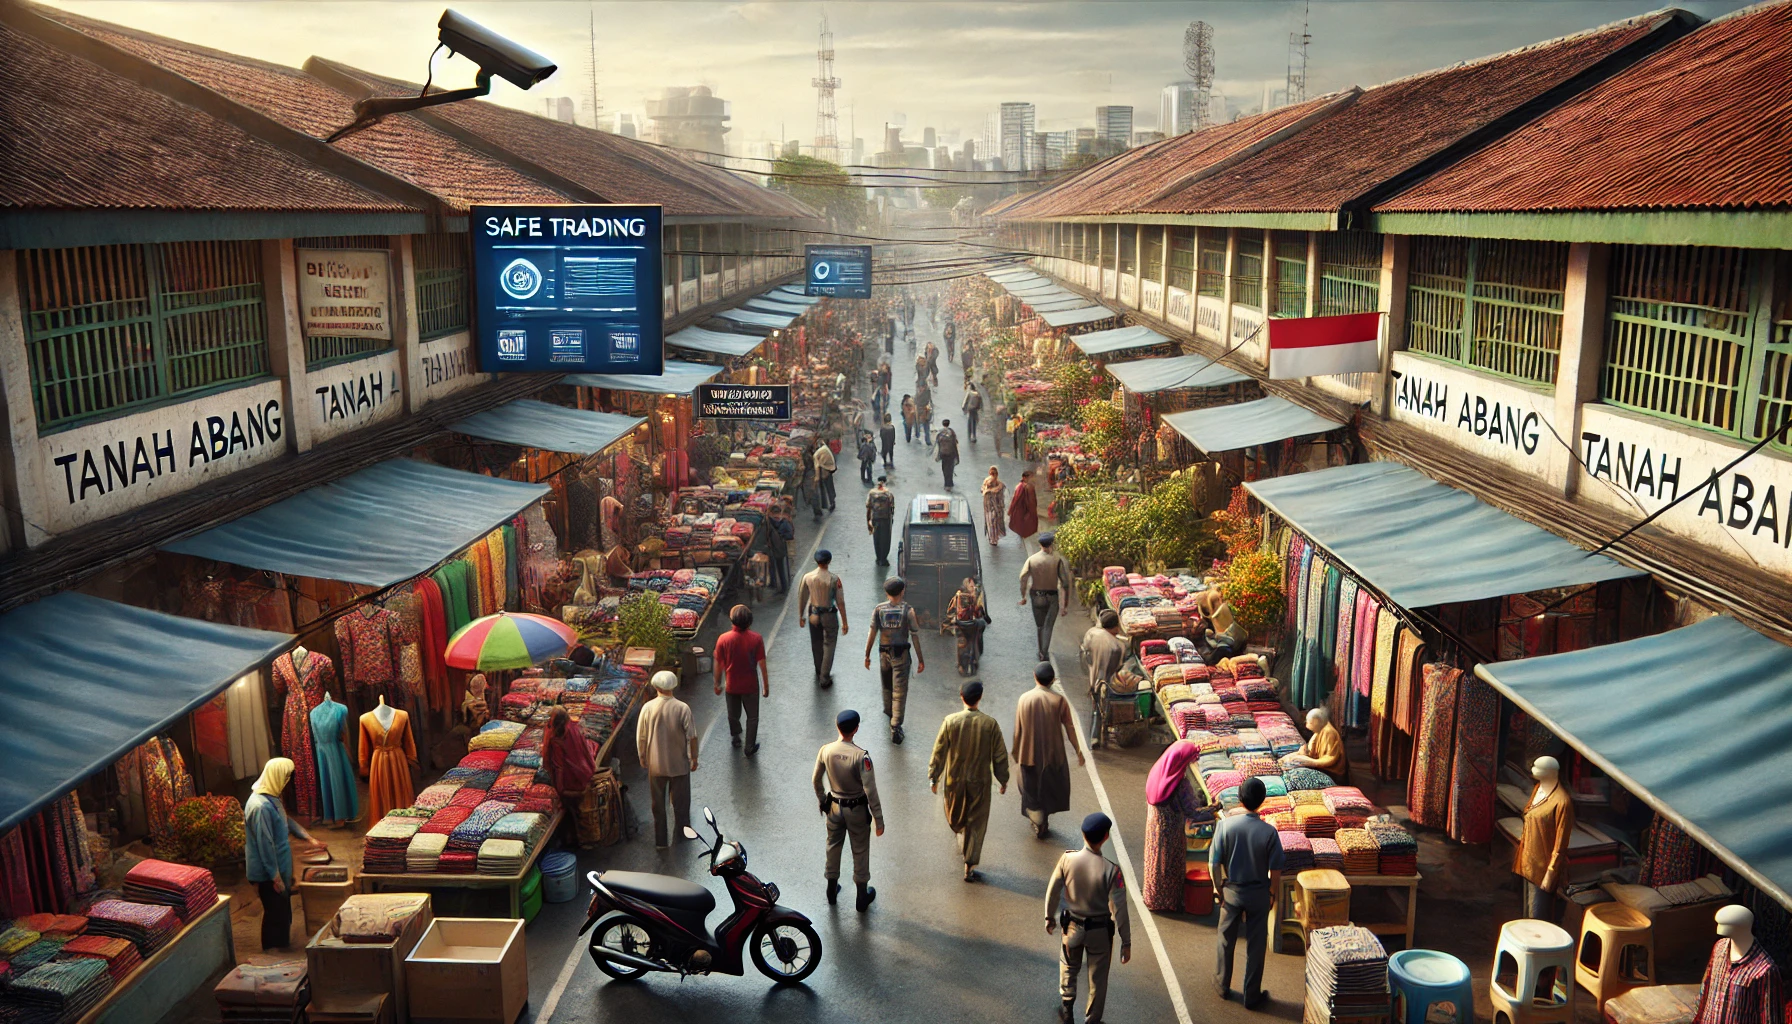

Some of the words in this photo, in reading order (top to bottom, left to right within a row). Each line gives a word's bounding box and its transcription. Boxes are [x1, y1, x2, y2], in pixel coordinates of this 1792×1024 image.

[485, 216, 543, 237] SAFE
[549, 217, 646, 238] TRADING
[315, 370, 383, 423] TANAH
[1390, 370, 1448, 422] TANAH
[1457, 391, 1540, 455] ABANG
[54, 429, 176, 504] TANAH
[189, 399, 282, 468] ABANG
[1581, 432, 1682, 502] TANAH
